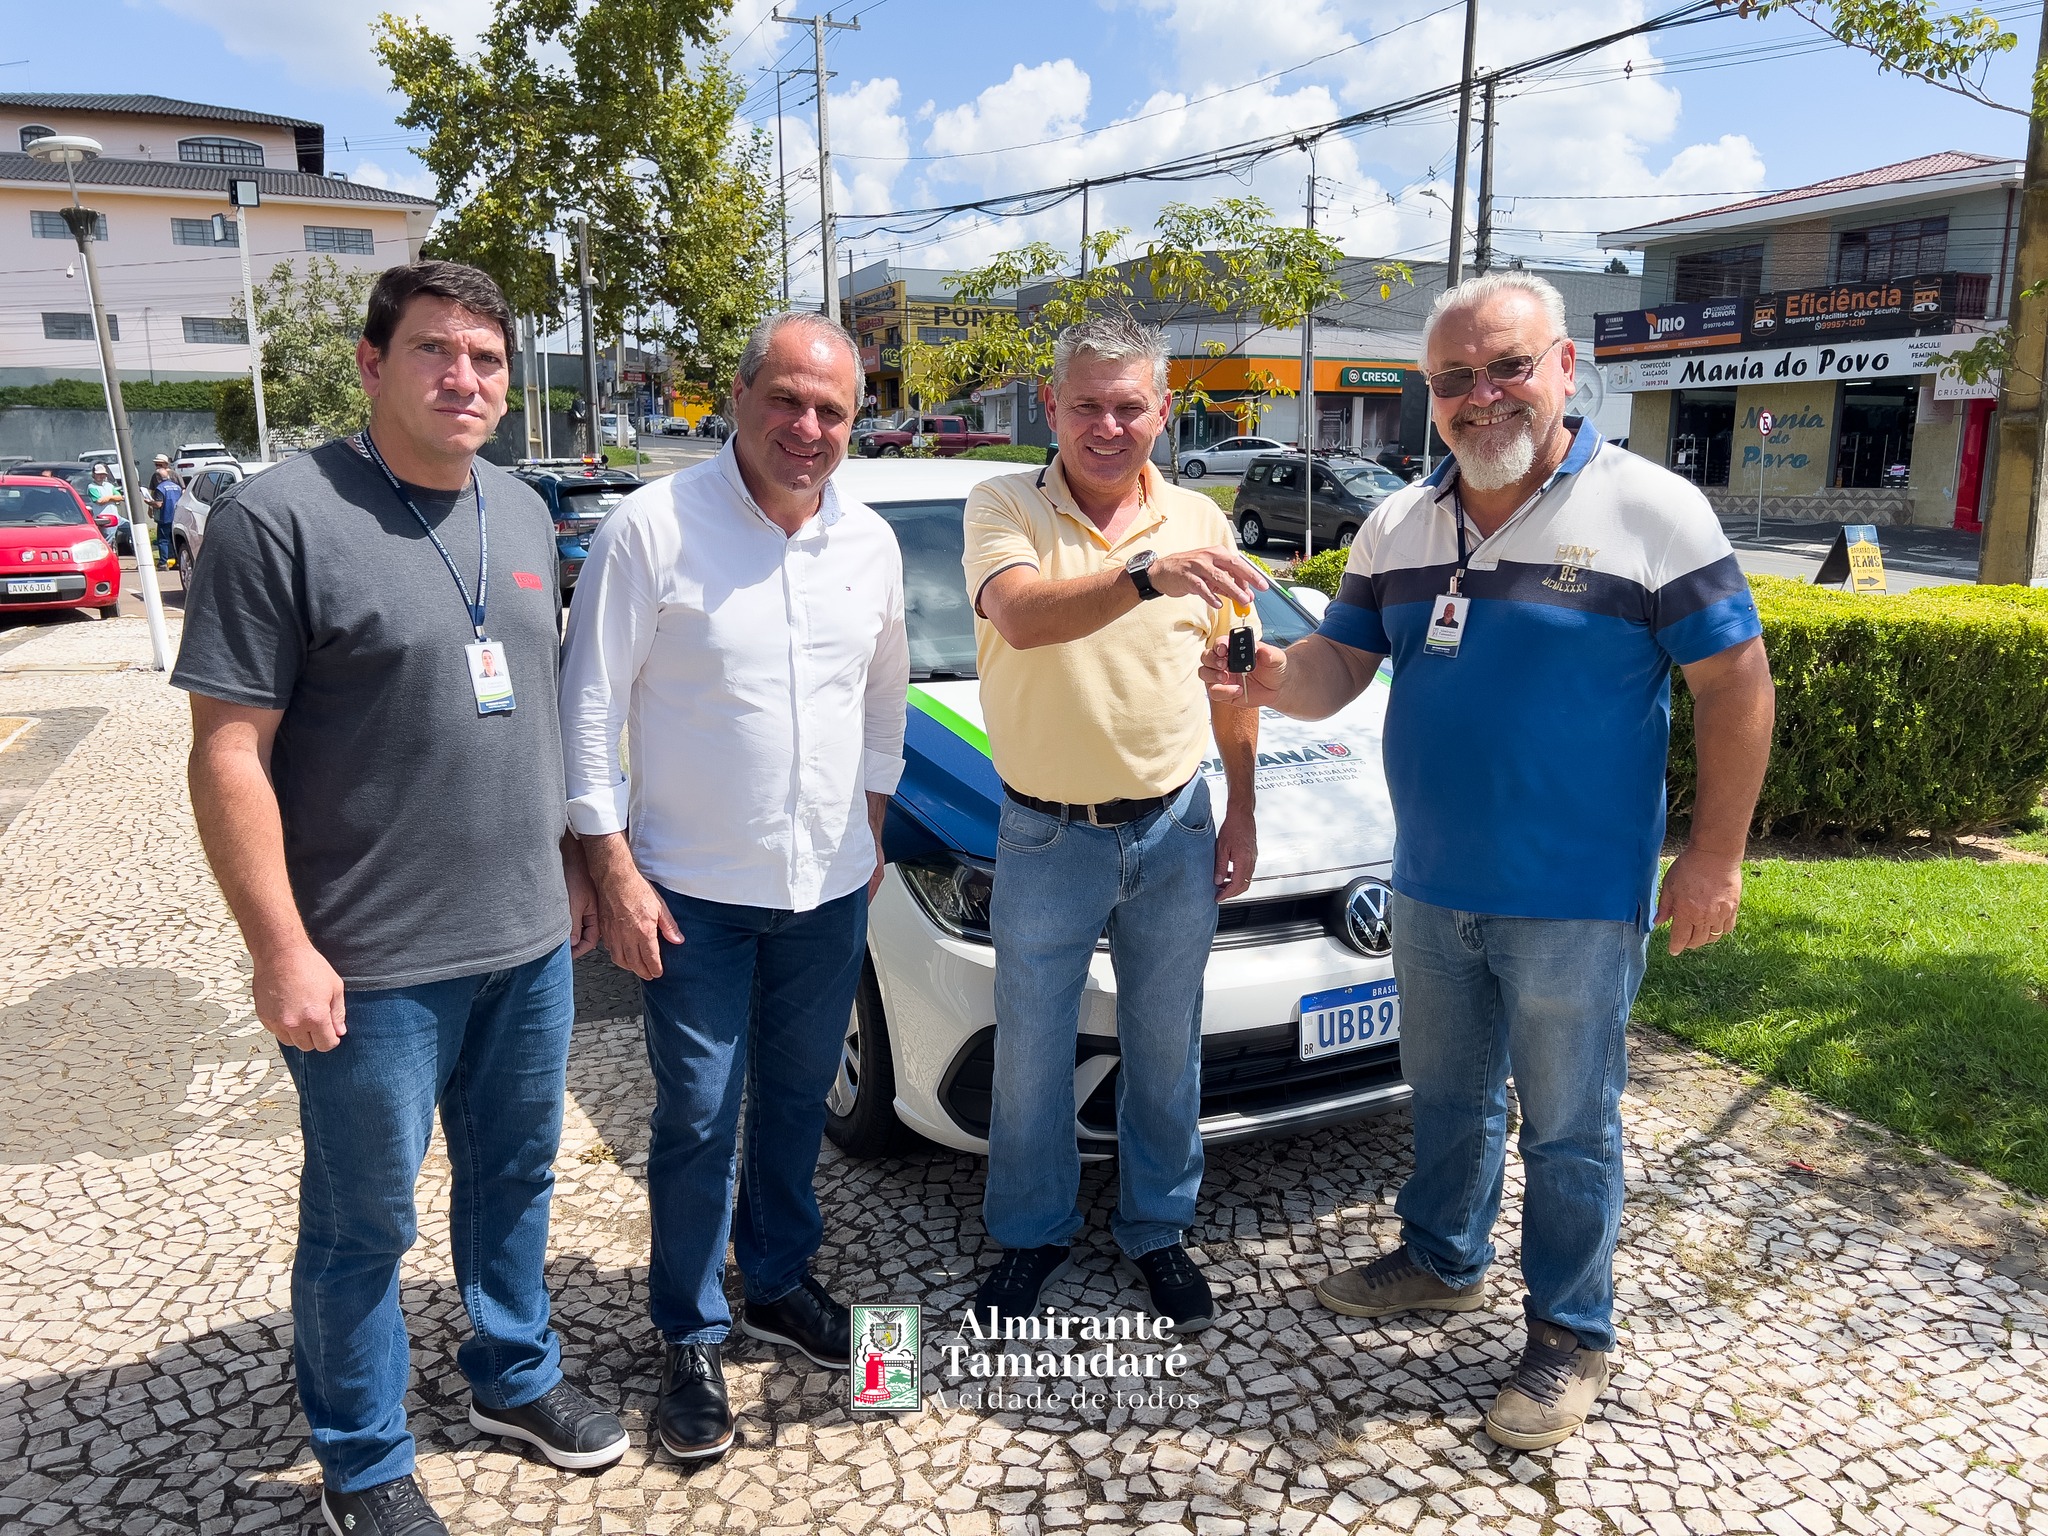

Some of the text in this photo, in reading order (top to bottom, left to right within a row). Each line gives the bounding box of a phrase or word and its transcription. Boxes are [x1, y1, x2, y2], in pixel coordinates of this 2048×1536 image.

[1785, 284, 1902, 317] Eficiência
[934, 306, 997, 328] PON
[1711, 310, 1736, 318] SERVOPA
[1784, 316, 1816, 325] Segurança
[1821, 312, 1848, 320] Facilities
[1854, 310, 1873, 318] Cyber
[1874, 306, 1900, 316] Security
[1821, 318, 1866, 330] 99957-1210
[1679, 348, 1890, 384] Mania do Povo
[1362, 370, 1400, 383] CRESOL
[1642, 370, 1668, 378] CALÇADOS
[1937, 388, 1993, 396] CRISTALINA
[1768, 430, 1791, 444] do
[1852, 555, 1880, 568] JEANS
[1558, 565, 1579, 583] 85
[12, 584, 52, 592] AVK6J06
[1541, 576, 1588, 592] MCMLXXXV
[1254, 778, 1314, 791] ALIFICAÇÃO
[1325, 774, 1358, 782] RENDA
[1318, 1000, 1395, 1048] UBB9
[1304, 1042, 1314, 1055] BR
